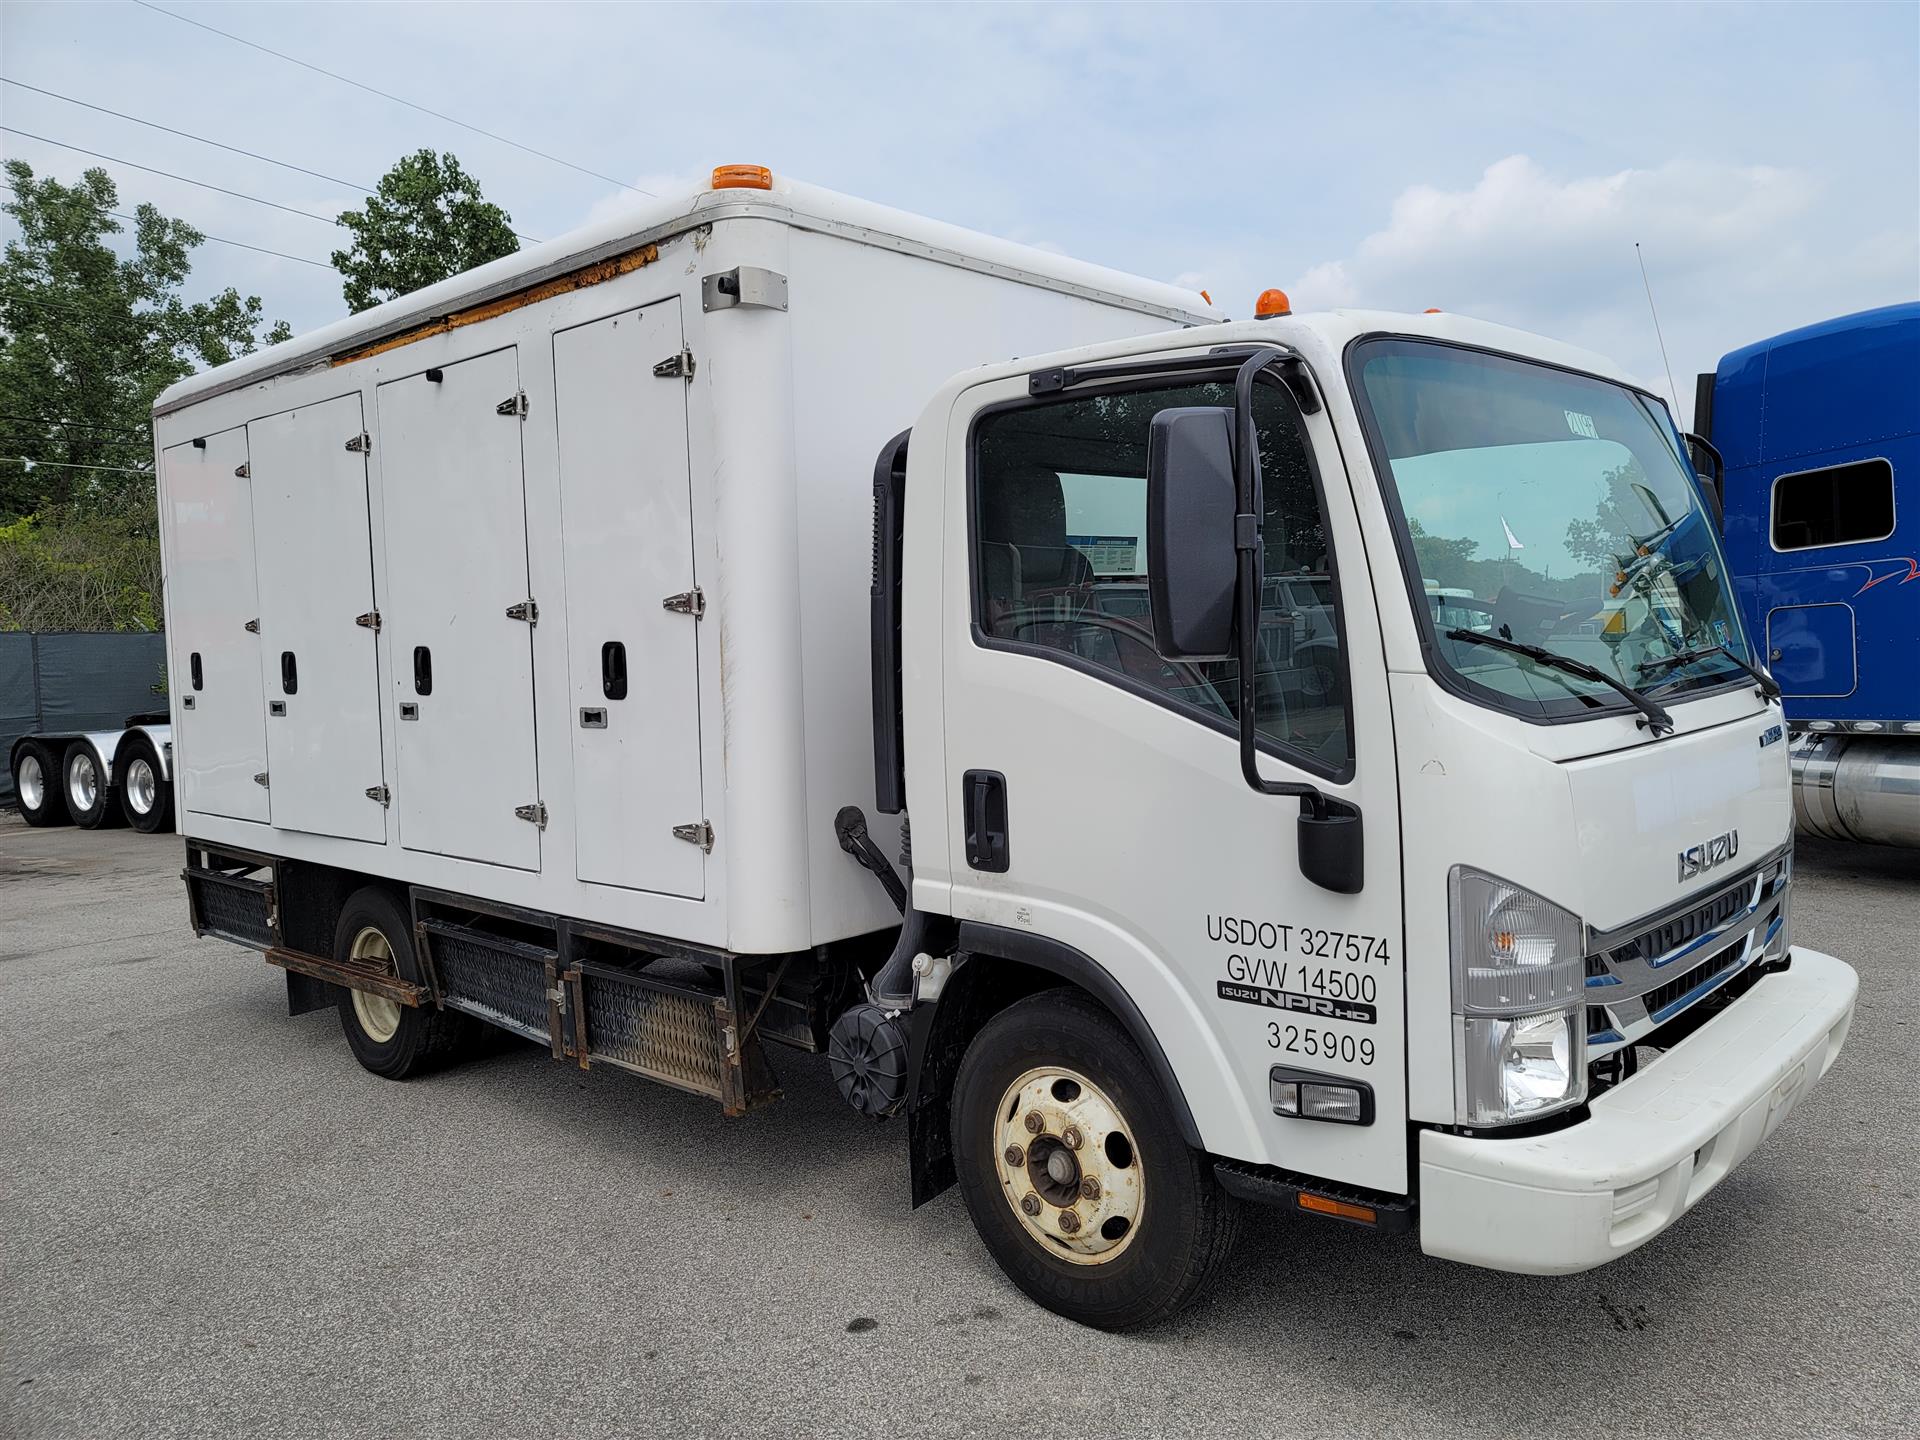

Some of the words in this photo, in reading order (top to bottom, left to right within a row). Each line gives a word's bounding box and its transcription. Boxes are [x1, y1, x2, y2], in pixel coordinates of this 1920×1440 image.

[1677, 828, 1739, 884] ISUZU
[1207, 914, 1293, 952] USDOT
[1300, 928, 1391, 966] 327574
[1227, 954, 1287, 989] GVW
[1298, 965, 1377, 1003] 14500
[1221, 986, 1259, 1000] ISUZU
[1260, 990, 1334, 1016] NPR
[1335, 1009, 1370, 1021] HD
[1267, 1022, 1375, 1066] 325909
